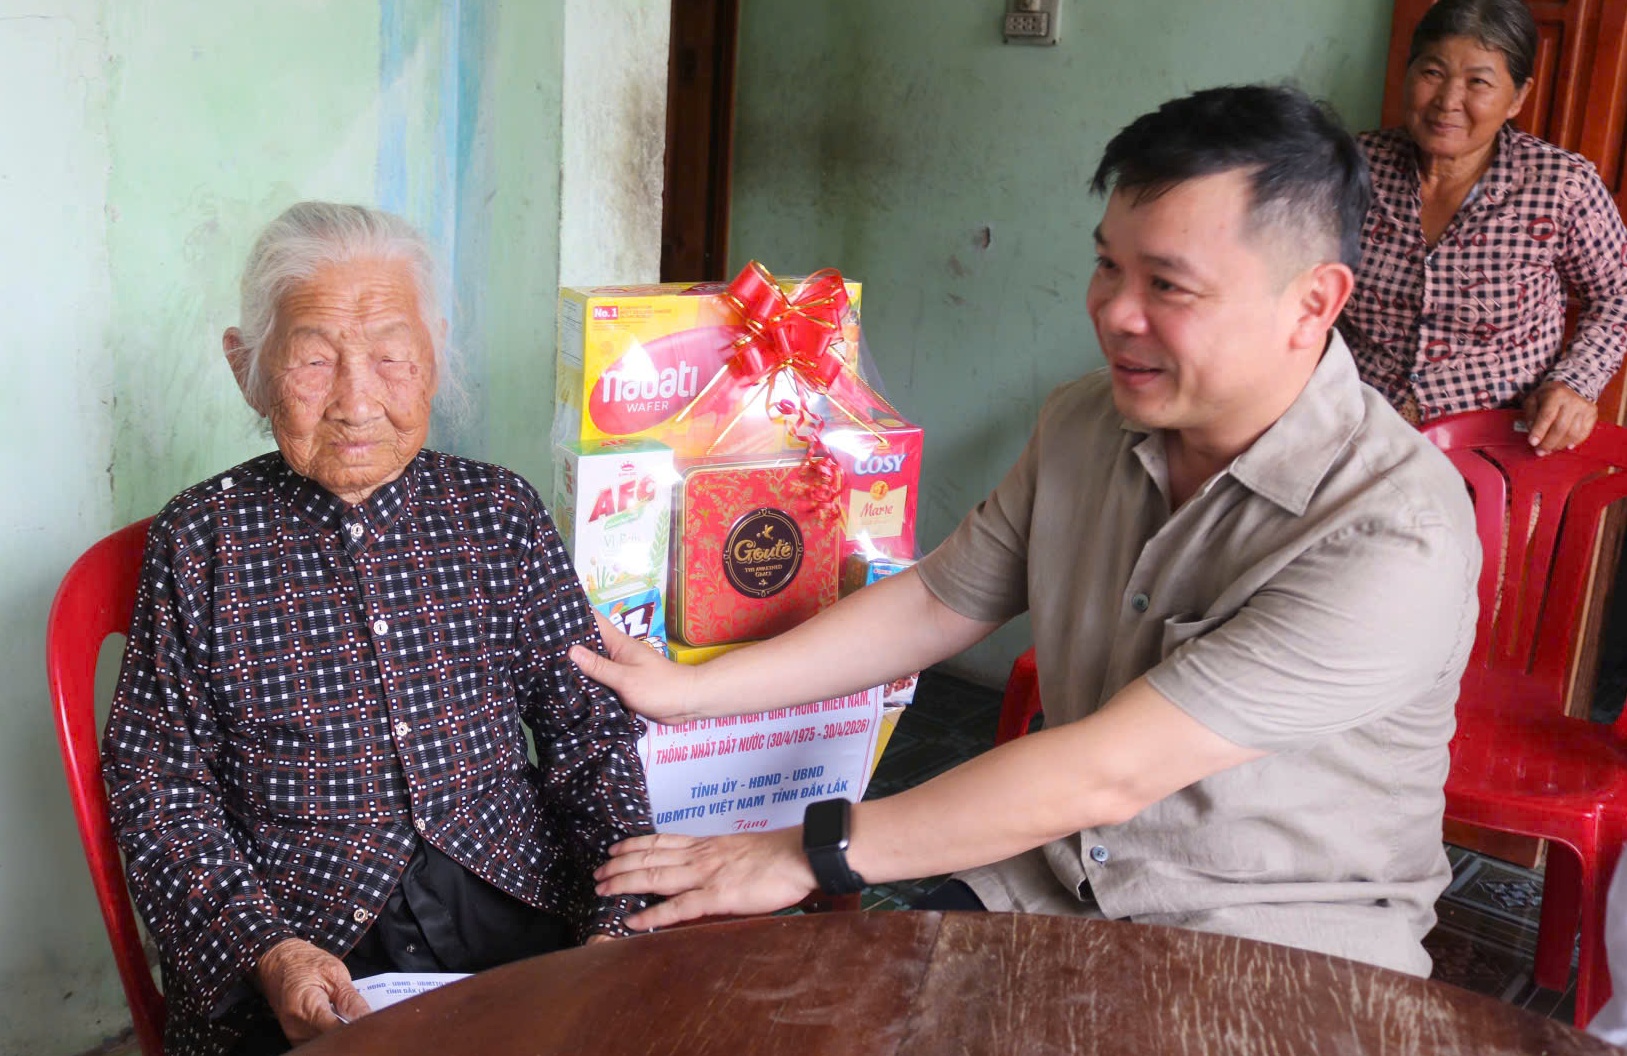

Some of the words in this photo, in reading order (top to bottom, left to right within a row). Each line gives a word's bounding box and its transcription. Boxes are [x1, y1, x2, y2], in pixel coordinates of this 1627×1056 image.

[627, 401, 669, 413] WAFER
[656, 741, 688, 765] THỐNG
[690, 736, 716, 759] NHẤT
[718, 733, 737, 755] ĐẤT
[738, 731, 764, 753] NƯỚC
[767, 726, 815, 749] (30/4/1975
[823, 719, 870, 740] 30/4/2026)
[691, 782, 719, 799] TỈNH
[722, 777, 737, 793] ỦY
[748, 773, 781, 789] HĐND
[792, 765, 824, 781] UBND
[656, 805, 705, 824] UBMTTQ
[709, 799, 734, 815] VIỆT
[737, 795, 765, 811] NAM
[772, 788, 798, 804] TỈNH
